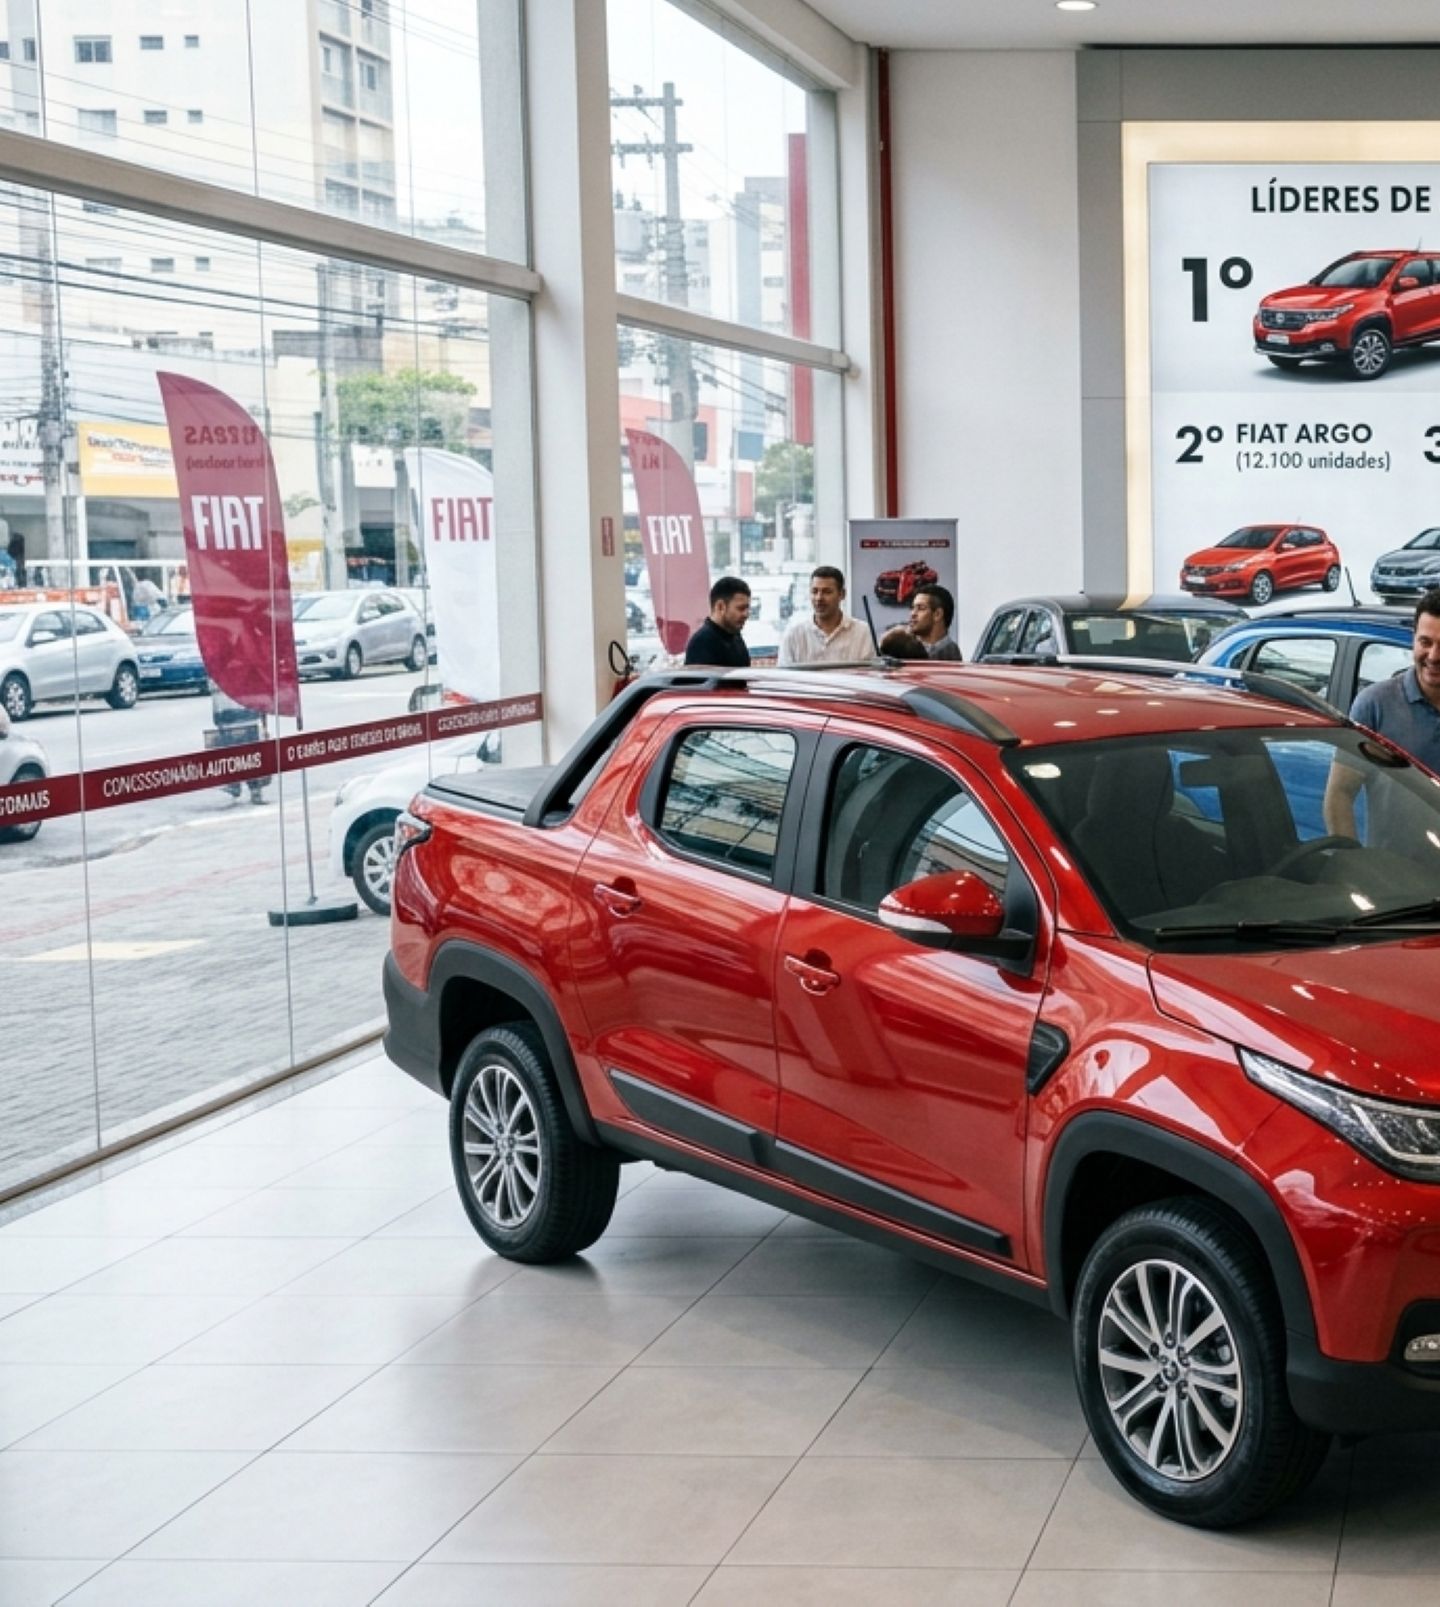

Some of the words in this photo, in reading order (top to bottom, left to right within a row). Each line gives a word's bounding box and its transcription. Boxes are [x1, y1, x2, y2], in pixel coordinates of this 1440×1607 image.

[1252, 177, 1380, 213] LÍDERES
[1390, 185, 1431, 213] DE
[1237, 423, 1288, 444] FIAT
[1295, 423, 1373, 444] ARGO
[1236, 451, 1303, 472] (12.100
[1308, 451, 1390, 472] unidades)
[191, 495, 264, 551] FIAT
[430, 497, 493, 541] FIAT
[647, 515, 693, 554] FIAT
